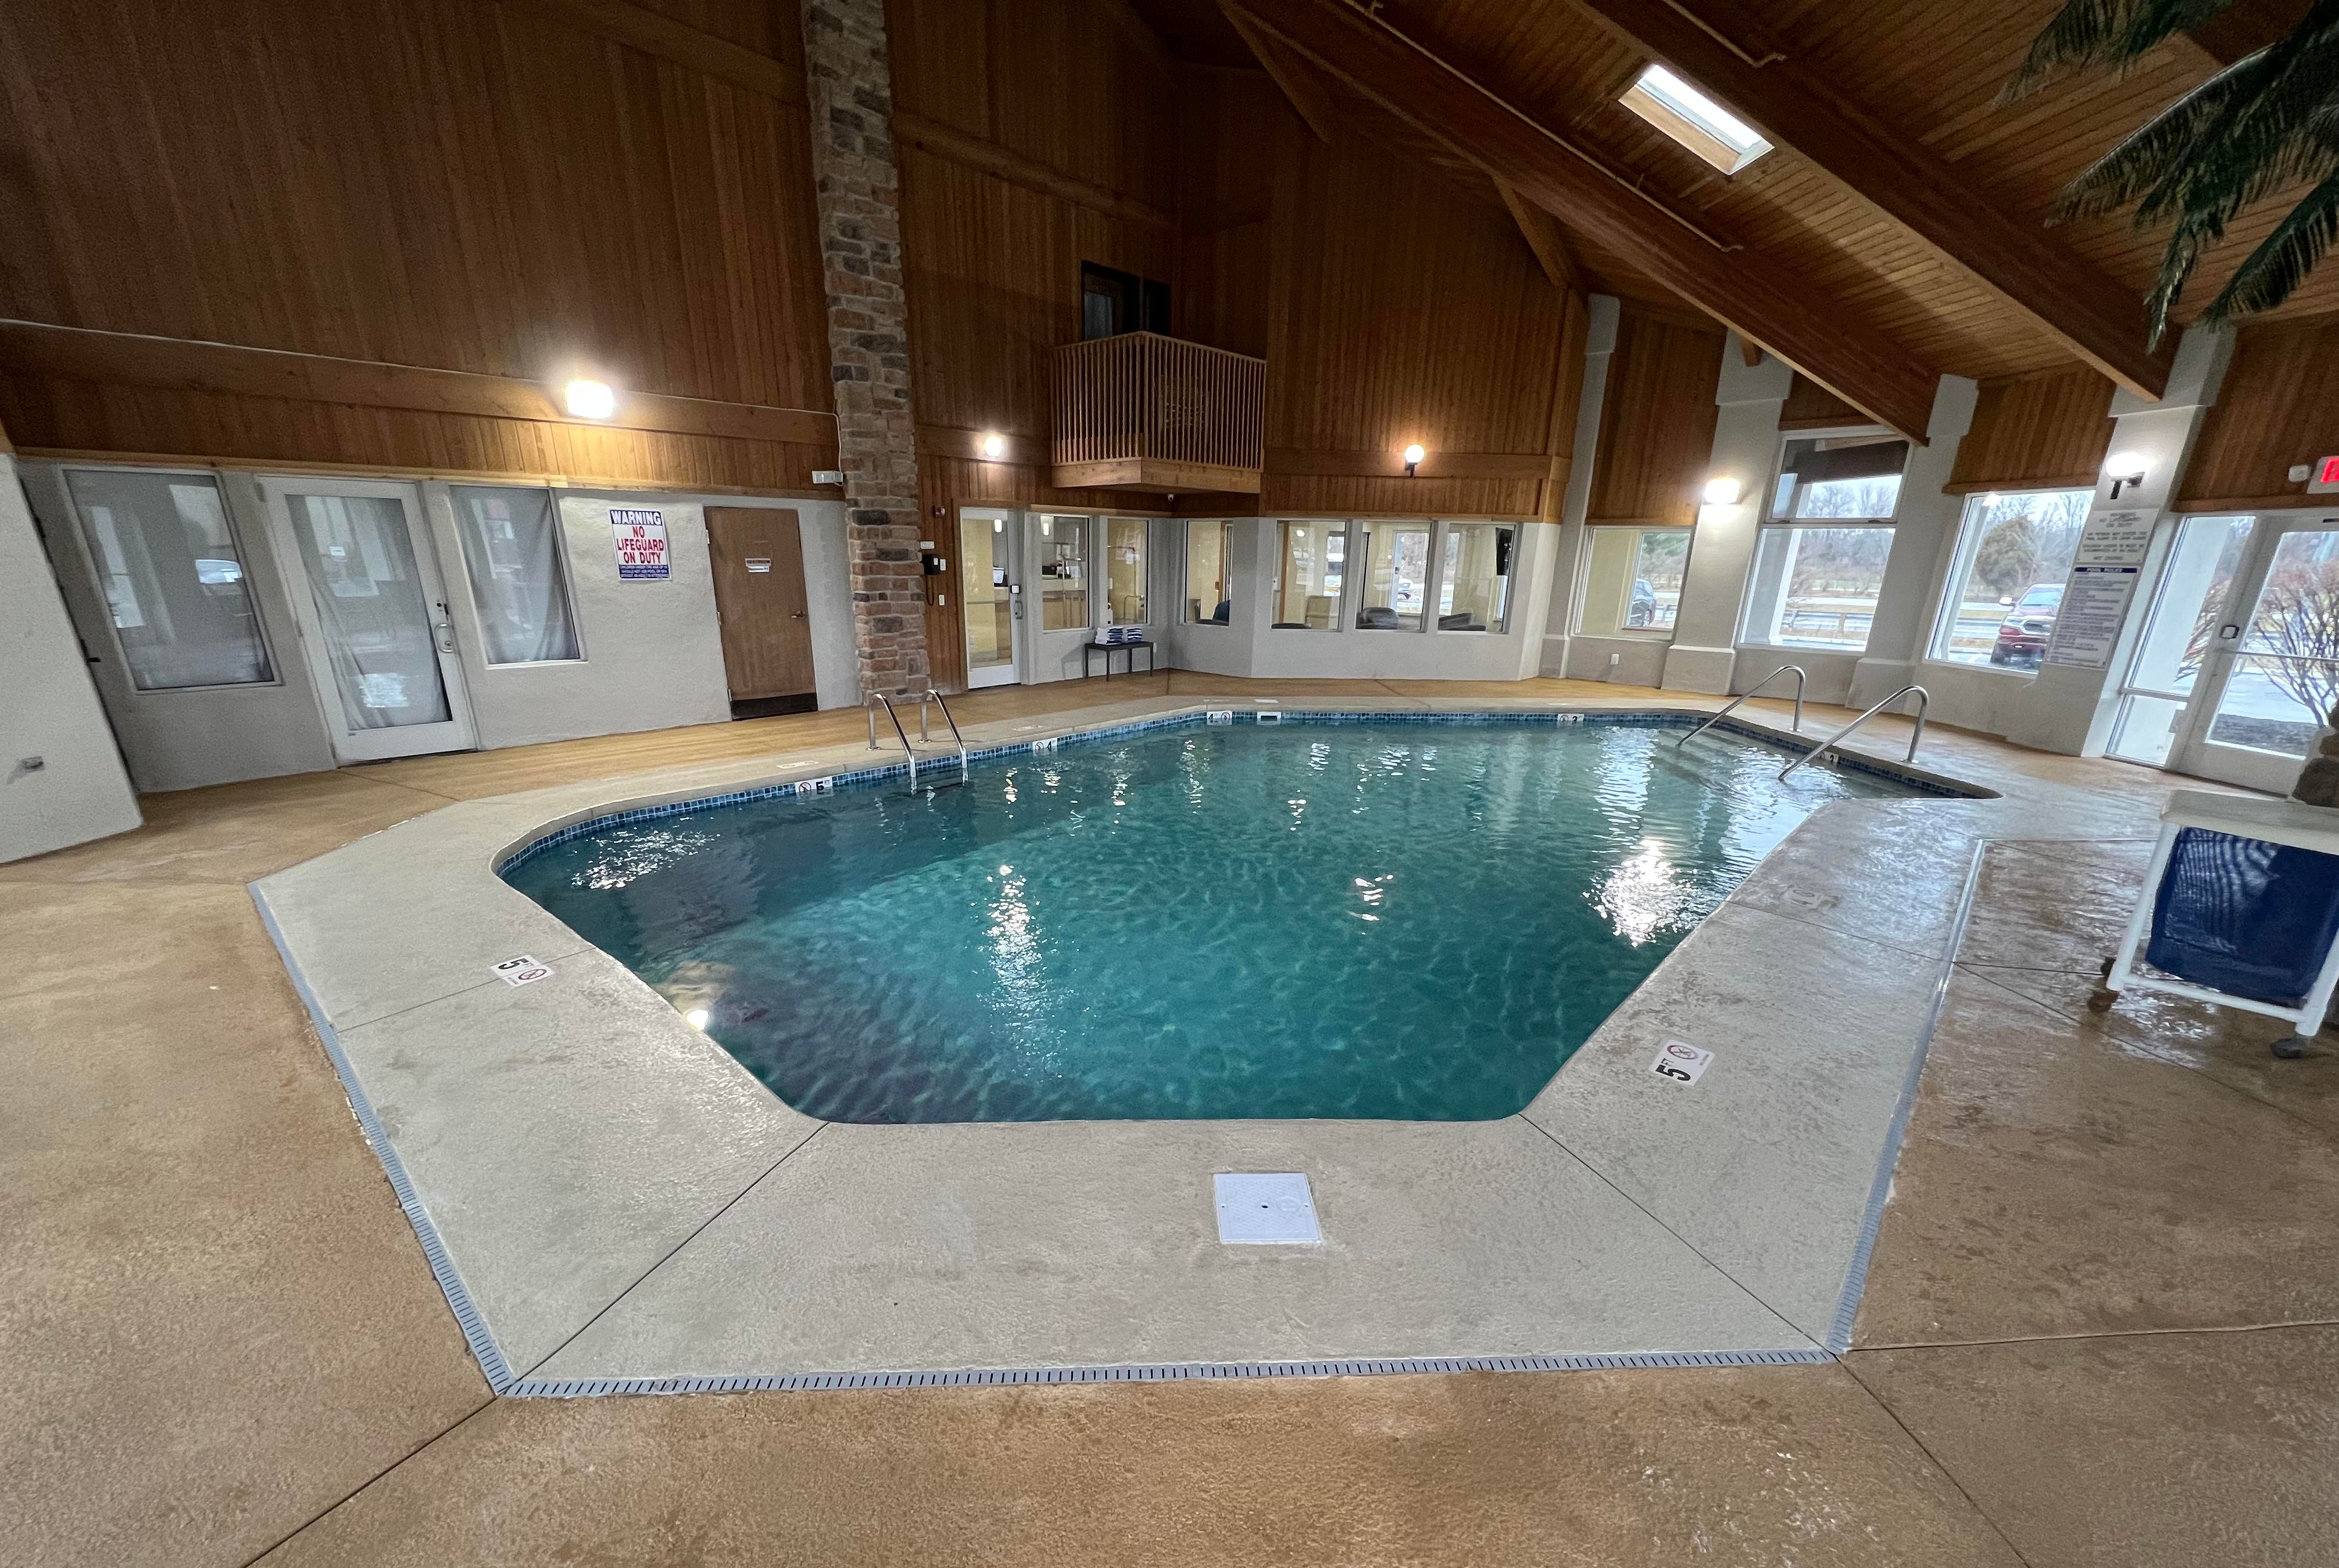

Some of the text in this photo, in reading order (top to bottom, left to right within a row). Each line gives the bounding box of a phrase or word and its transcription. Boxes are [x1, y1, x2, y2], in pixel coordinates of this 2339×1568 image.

[610, 510, 661, 525] WARNING
[632, 525, 645, 538] NO
[617, 538, 664, 551] LIFEGUARD
[624, 552, 661, 564] ON DUTY
[816, 781, 824, 794] 5
[498, 958, 528, 969] 5
[1655, 1064, 1691, 1081] 5
